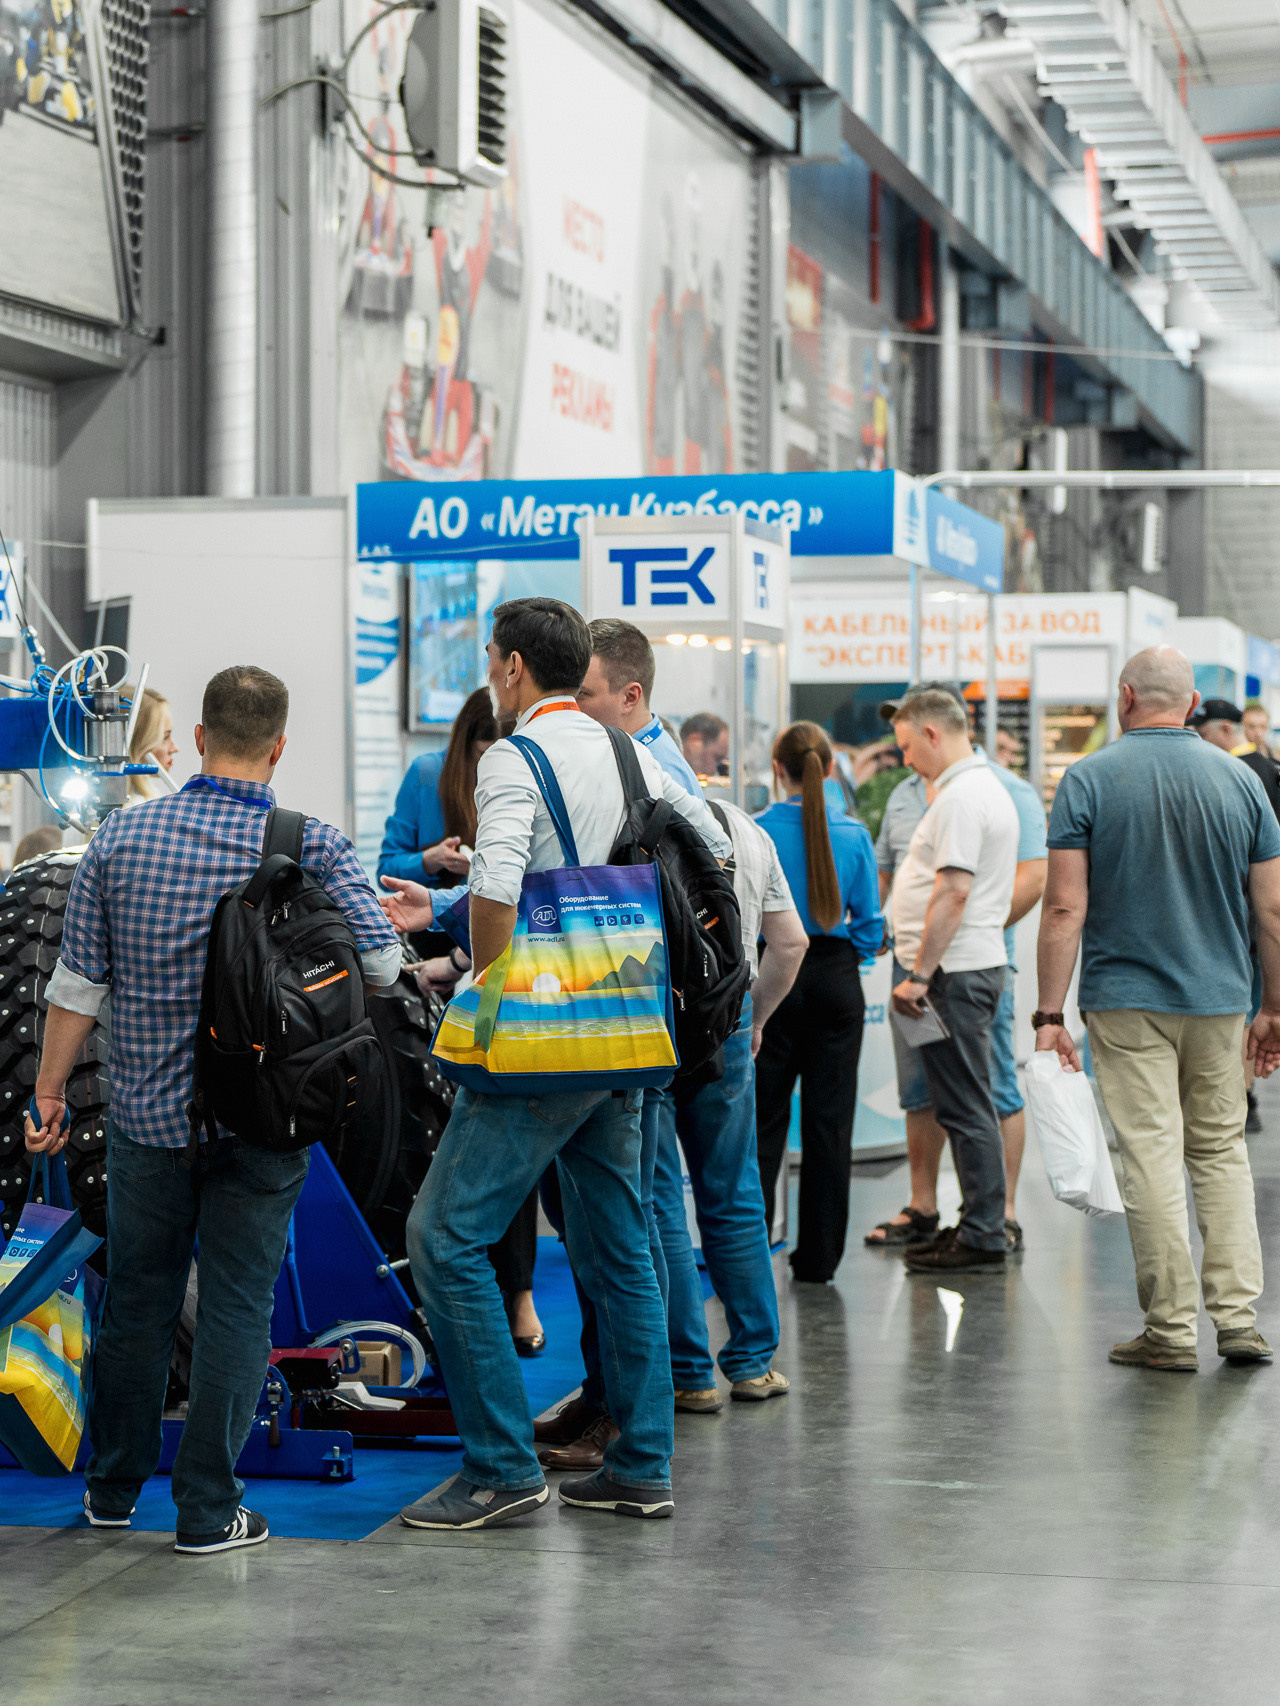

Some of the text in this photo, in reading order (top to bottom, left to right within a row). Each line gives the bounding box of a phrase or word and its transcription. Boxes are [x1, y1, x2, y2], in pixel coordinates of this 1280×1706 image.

[409, 497, 469, 539] АО
[559, 895, 609, 904] Оборудование
[560, 906, 574, 914] для
[303, 960, 336, 979] HITACHI
